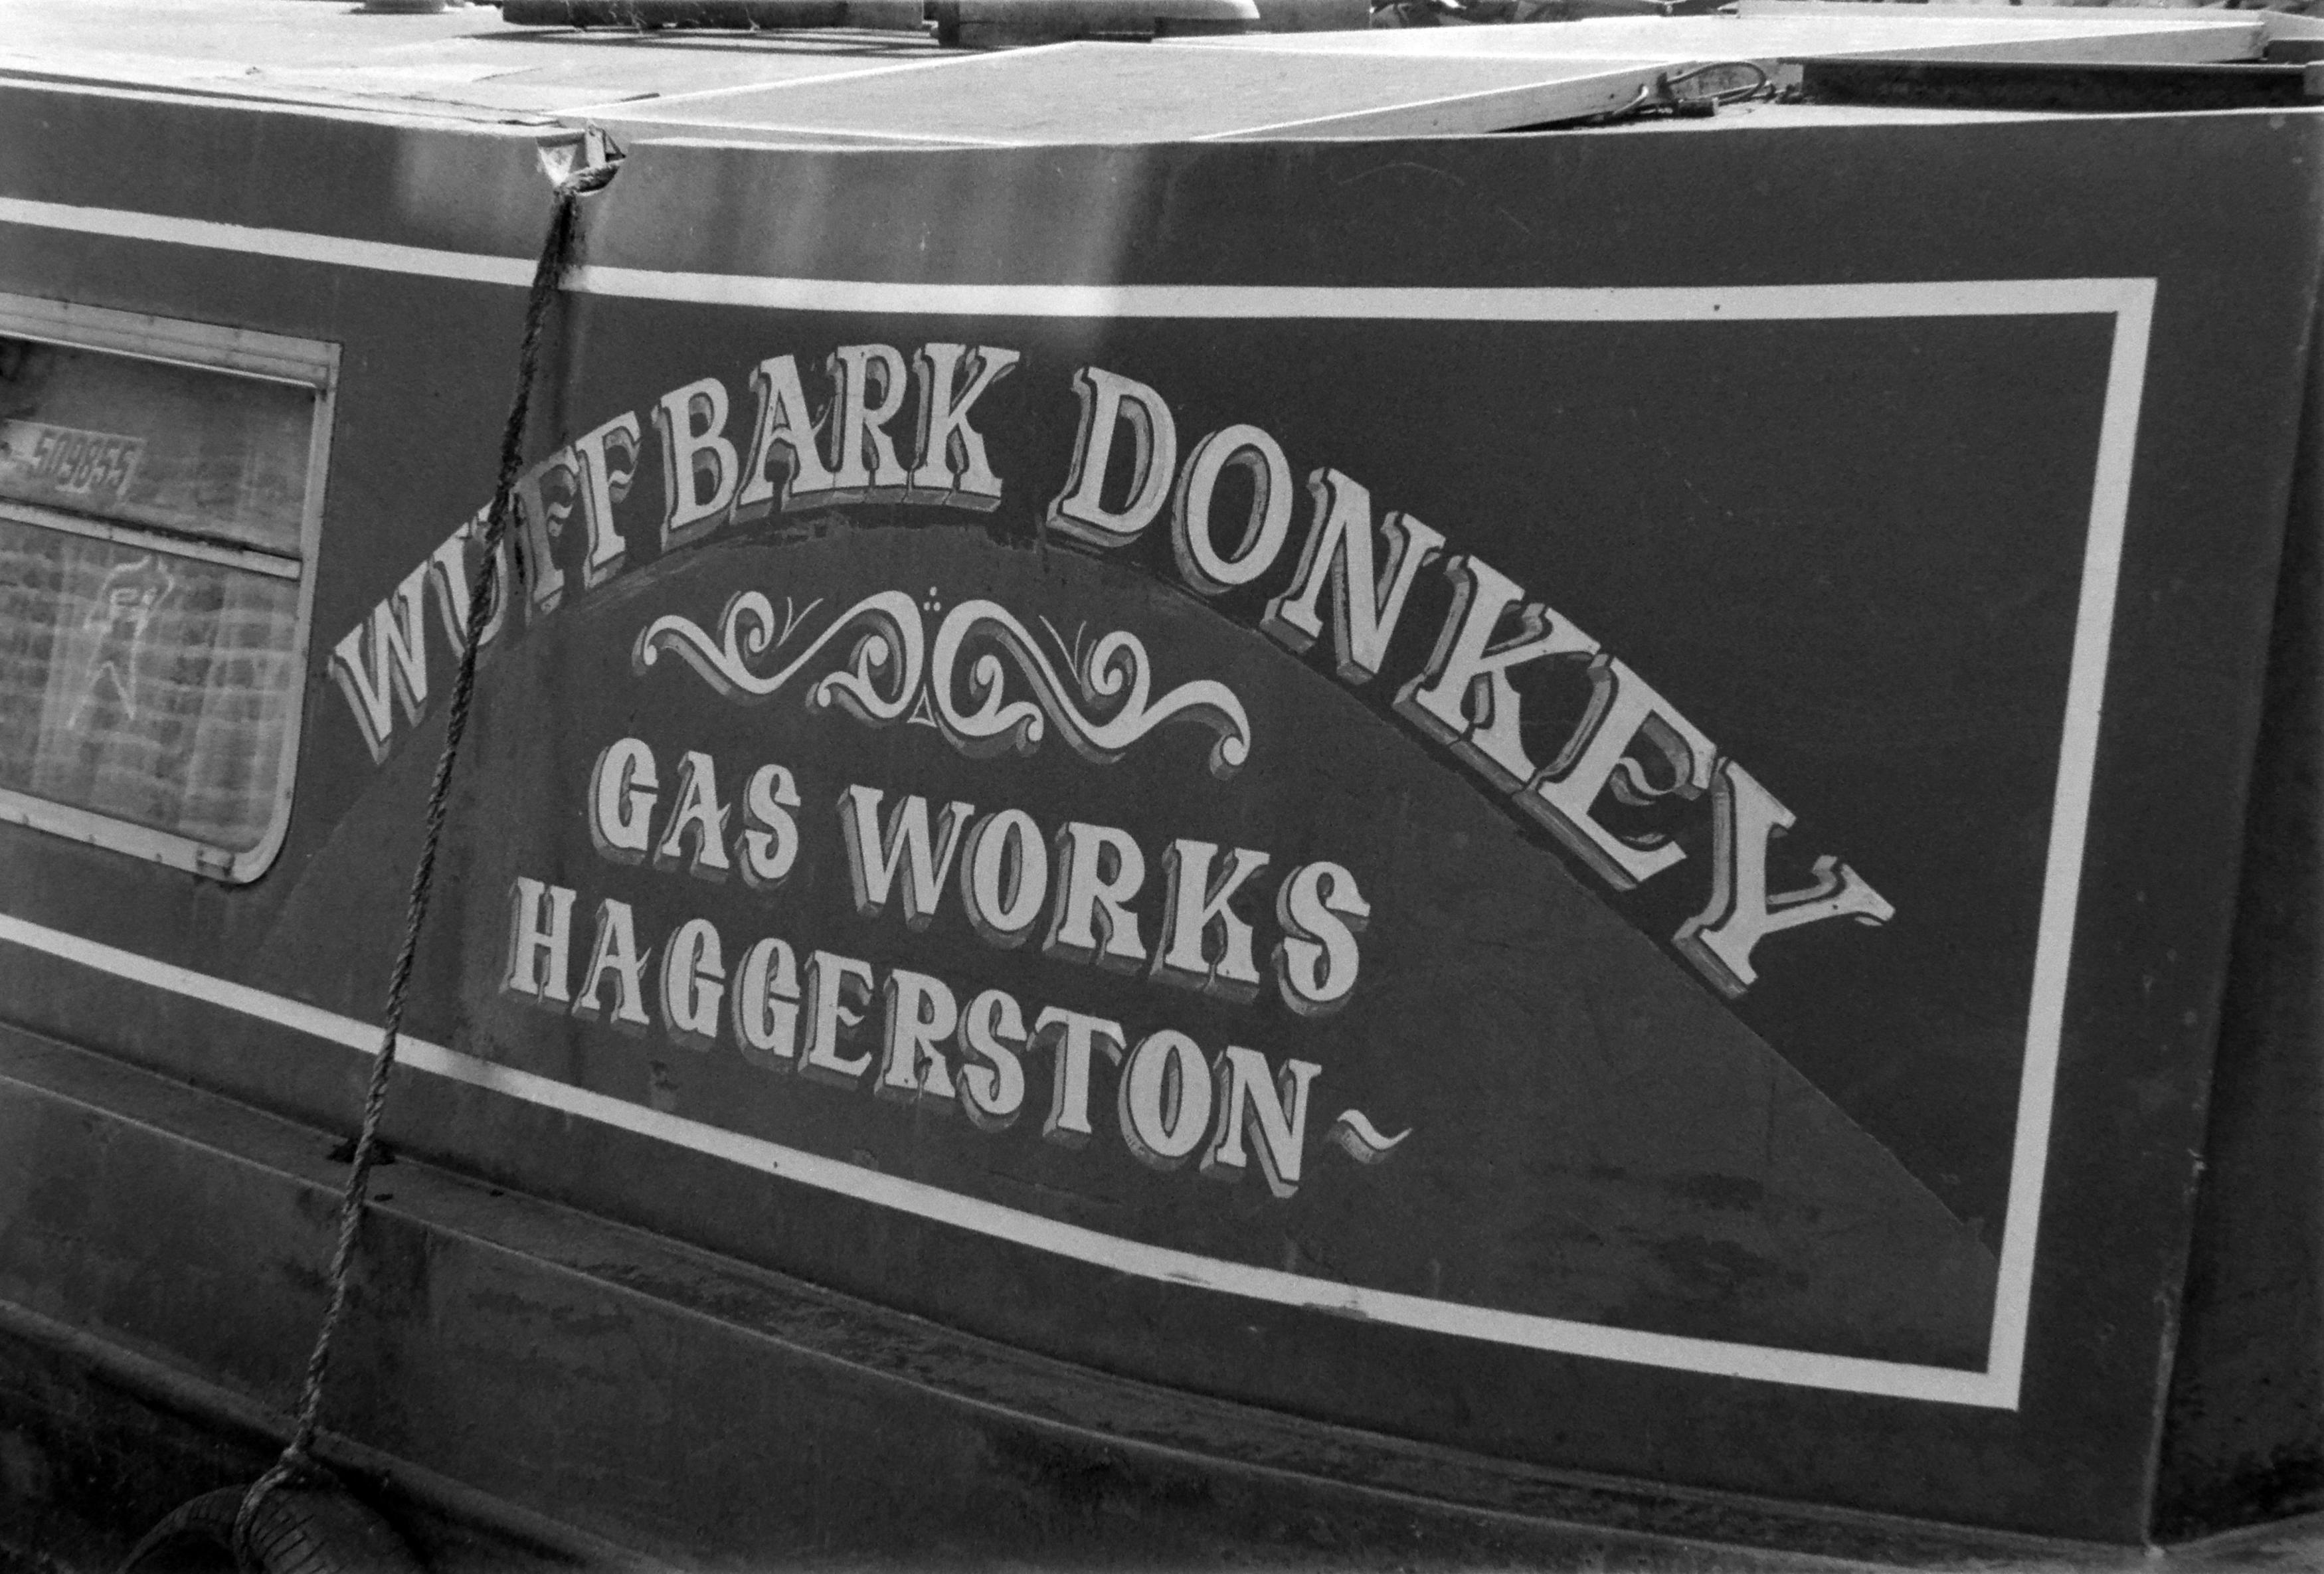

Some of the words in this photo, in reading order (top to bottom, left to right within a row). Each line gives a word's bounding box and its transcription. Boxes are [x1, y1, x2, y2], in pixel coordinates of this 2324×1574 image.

[1046, 365, 1896, 1000] DONKEY
[498, 876, 1322, 1198] HAGGERSTON
[588, 737, 801, 890] GAS
[837, 784, 1371, 1019] WORKS
